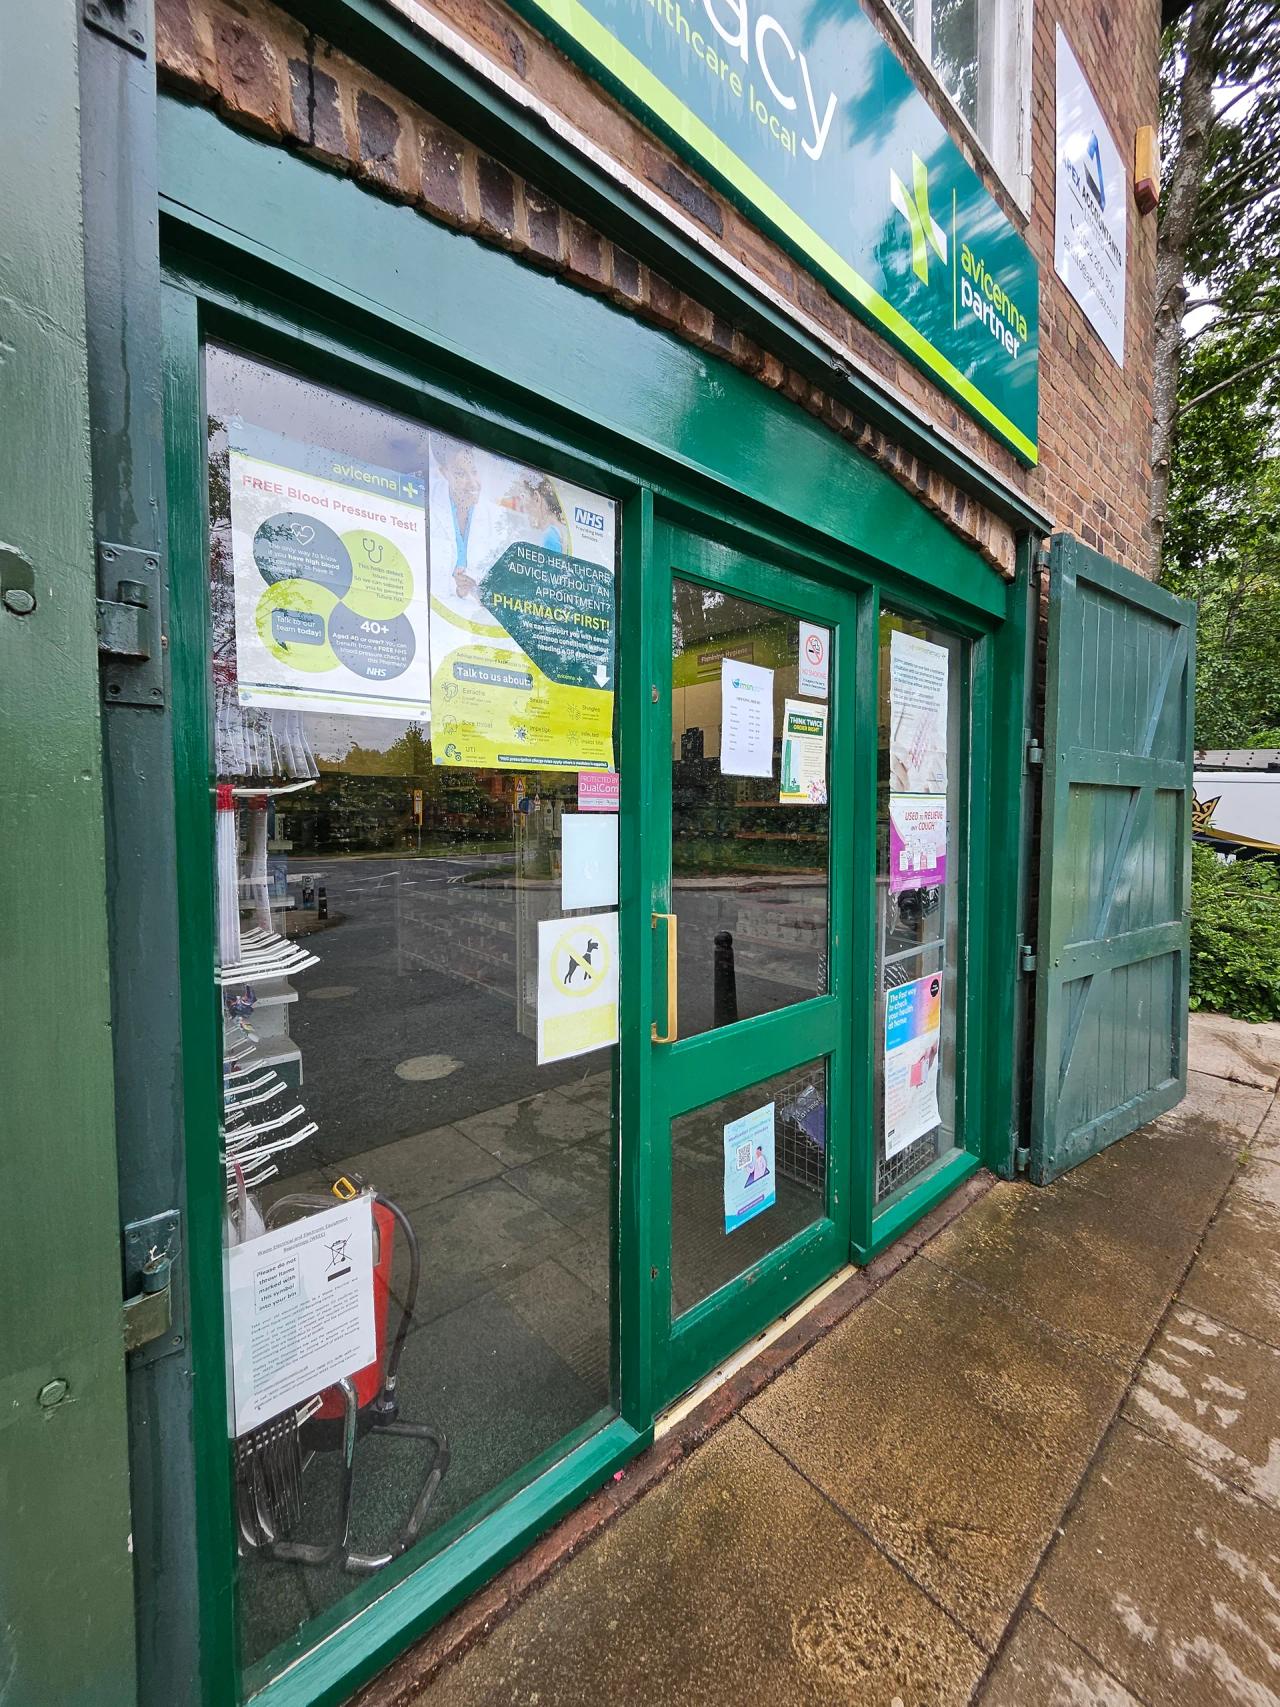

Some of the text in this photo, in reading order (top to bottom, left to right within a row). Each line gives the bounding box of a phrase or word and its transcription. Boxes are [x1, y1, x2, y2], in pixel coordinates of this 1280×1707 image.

[647, 0, 796, 157] thcare local
[691, 0, 838, 161] acy
[1082, 186, 1122, 267] ACCOUNTANTS
[961, 243, 1027, 342] avicenna
[961, 276, 1020, 360] partner
[332, 462, 398, 491] avicenna
[242, 474, 417, 531] FREE Blood Pressure Test!
[575, 509, 603, 530] NHS
[288, 553, 303, 562] have
[305, 557, 319, 567] high
[321, 561, 339, 570] blood
[517, 545, 609, 582] NEED HEALTHCARE
[508, 561, 609, 597] ADVICE WITHOUT AN
[535, 585, 610, 613] APPOINTMENT?
[276, 615, 291, 624] Talk
[493, 593, 610, 632] PHARMACY FIRST!
[276, 624, 321, 637] team today!
[332, 631, 349, 640] Aged
[360, 620, 389, 635] 40+
[378, 645, 393, 653] FREE
[366, 666, 386, 677] NHS
[457, 667, 530, 687] Talk to us about:
[790, 716, 823, 728] THINK TWICE
[580, 782, 619, 793] DualCom
[905, 811, 918, 821] USED
[924, 811, 943, 820] RELIEVE
[890, 994, 898, 1003] The
[256, 1265, 275, 1278] Please
[286, 1257, 296, 1265] not
[259, 1265, 294, 1285] throw items
[258, 1274, 295, 1294] marked with
[261, 1283, 294, 1302] this symbol
[259, 1290, 296, 1311] into your bin
